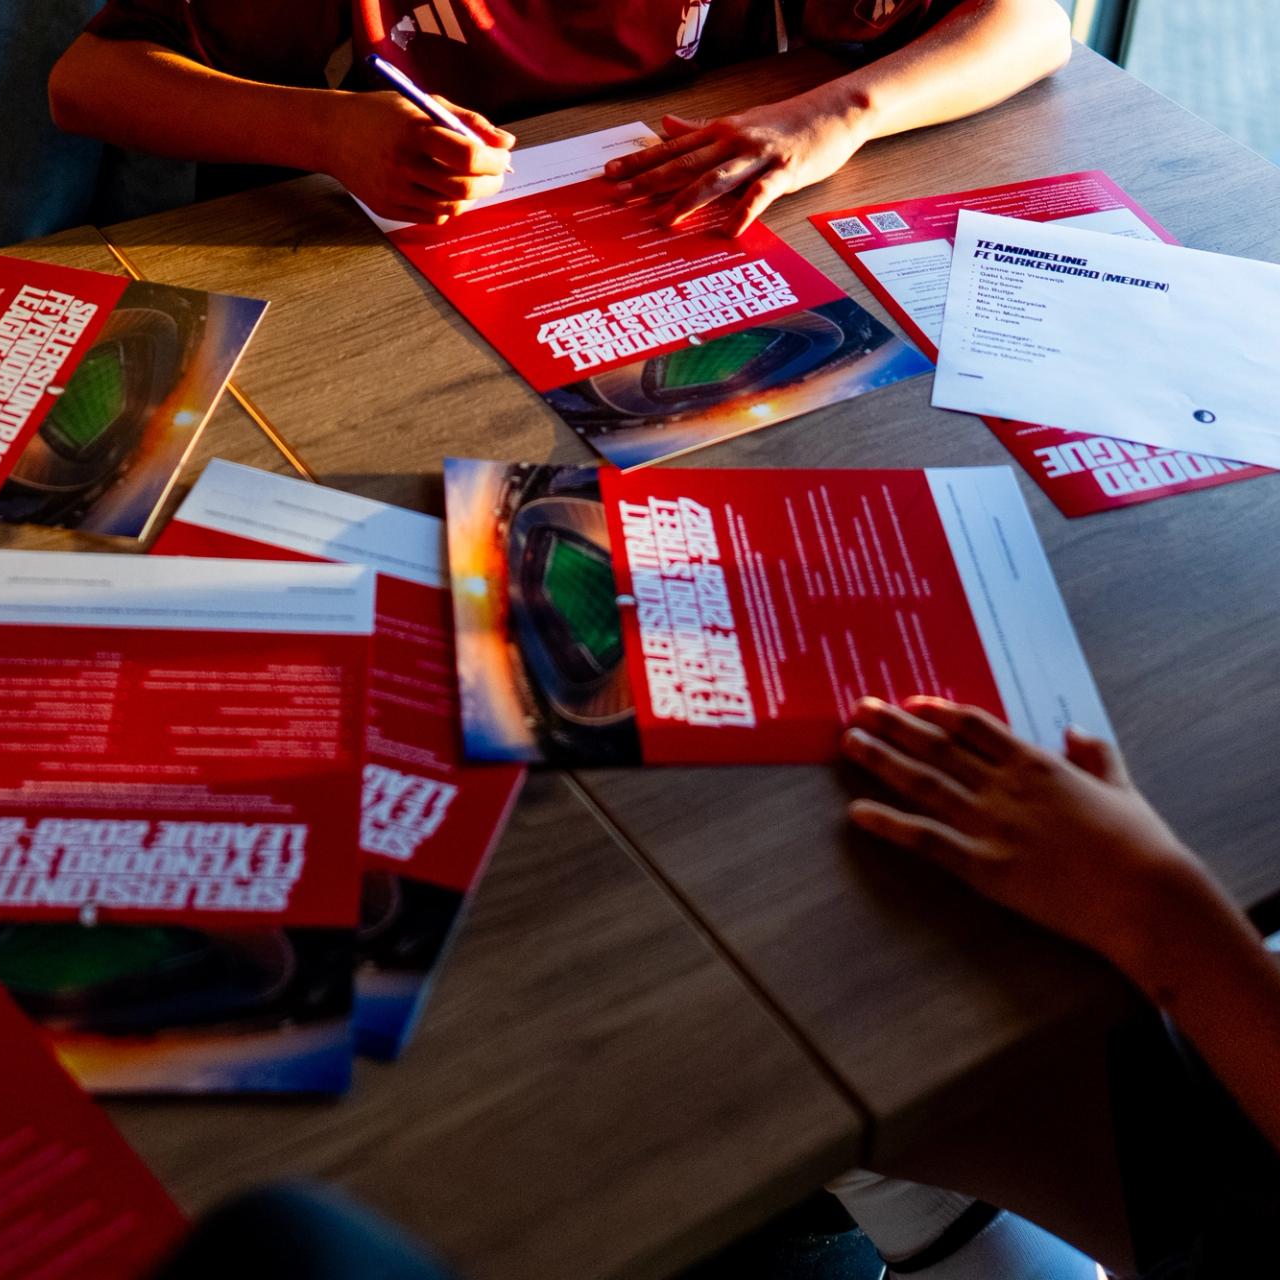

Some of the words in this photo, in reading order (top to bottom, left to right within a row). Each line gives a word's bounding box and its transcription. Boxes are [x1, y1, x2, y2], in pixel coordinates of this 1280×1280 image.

[678, 258, 776, 300] LEAGUE
[972, 249, 990, 260] FC
[993, 252, 1101, 281] VARKENOORD
[1101, 271, 1171, 294] (MEIDEN)
[976, 239, 1088, 268] TEAMINDELING
[535, 285, 683, 345] 2026-2027
[548, 316, 644, 359] STREET
[568, 287, 799, 372] SPELERSCONTRACT
[638, 271, 791, 345] FEYENOORD
[1033, 436, 1175, 479] AGUE
[648, 495, 696, 578] STREET
[618, 499, 687, 720] SPELERSCONTRACT
[662, 577, 721, 728] FEYENOORD
[702, 629, 756, 729] LEAGUE
